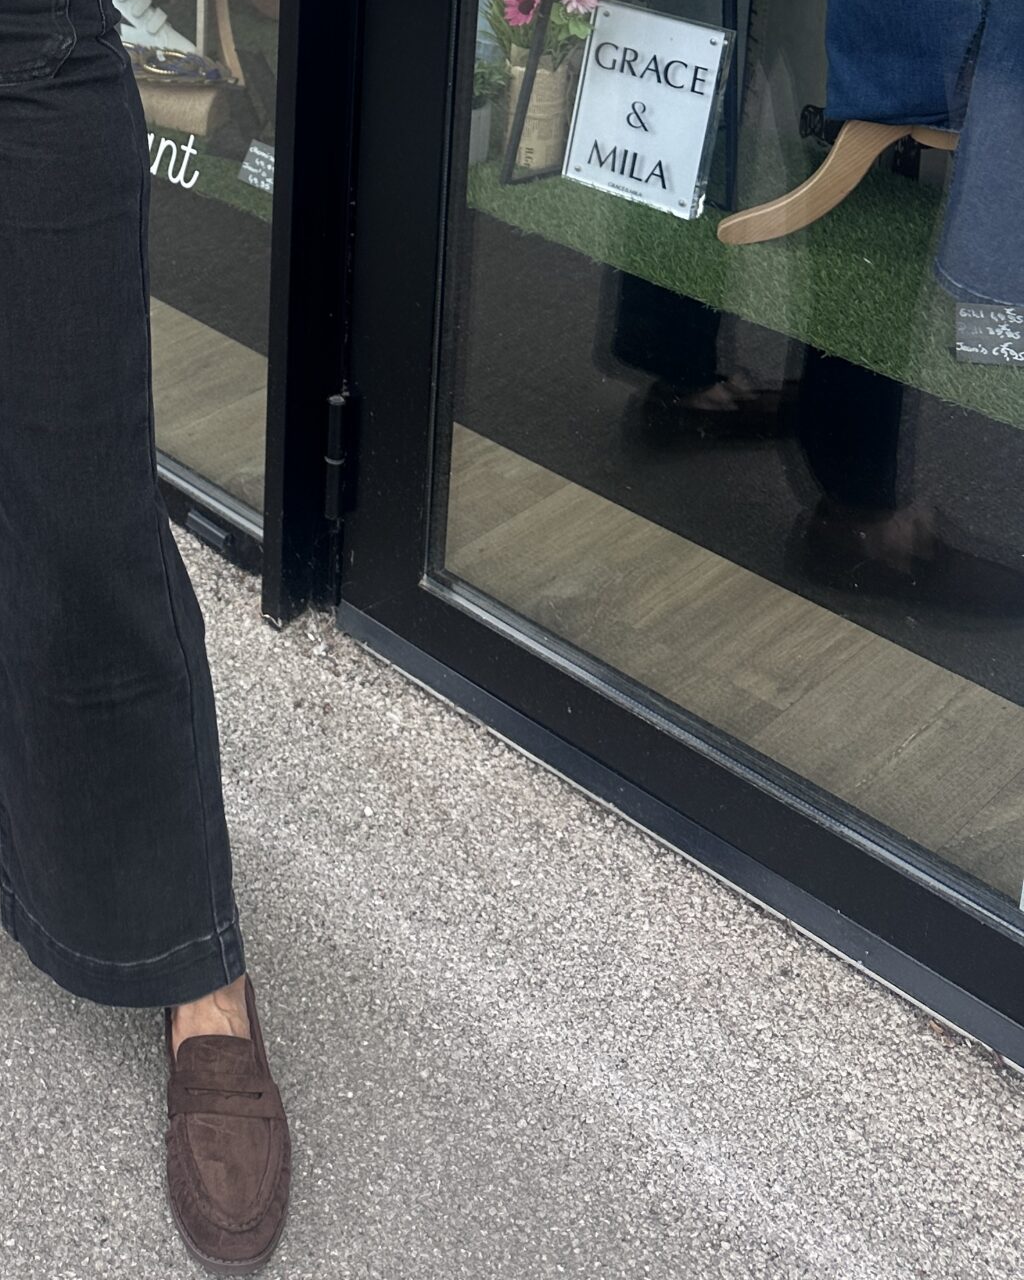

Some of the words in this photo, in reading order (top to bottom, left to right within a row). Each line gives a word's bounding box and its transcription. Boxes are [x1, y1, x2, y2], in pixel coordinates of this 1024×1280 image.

[594, 42, 709, 96] GRACE
[626, 100, 649, 132] &
[587, 139, 667, 190] MILA
